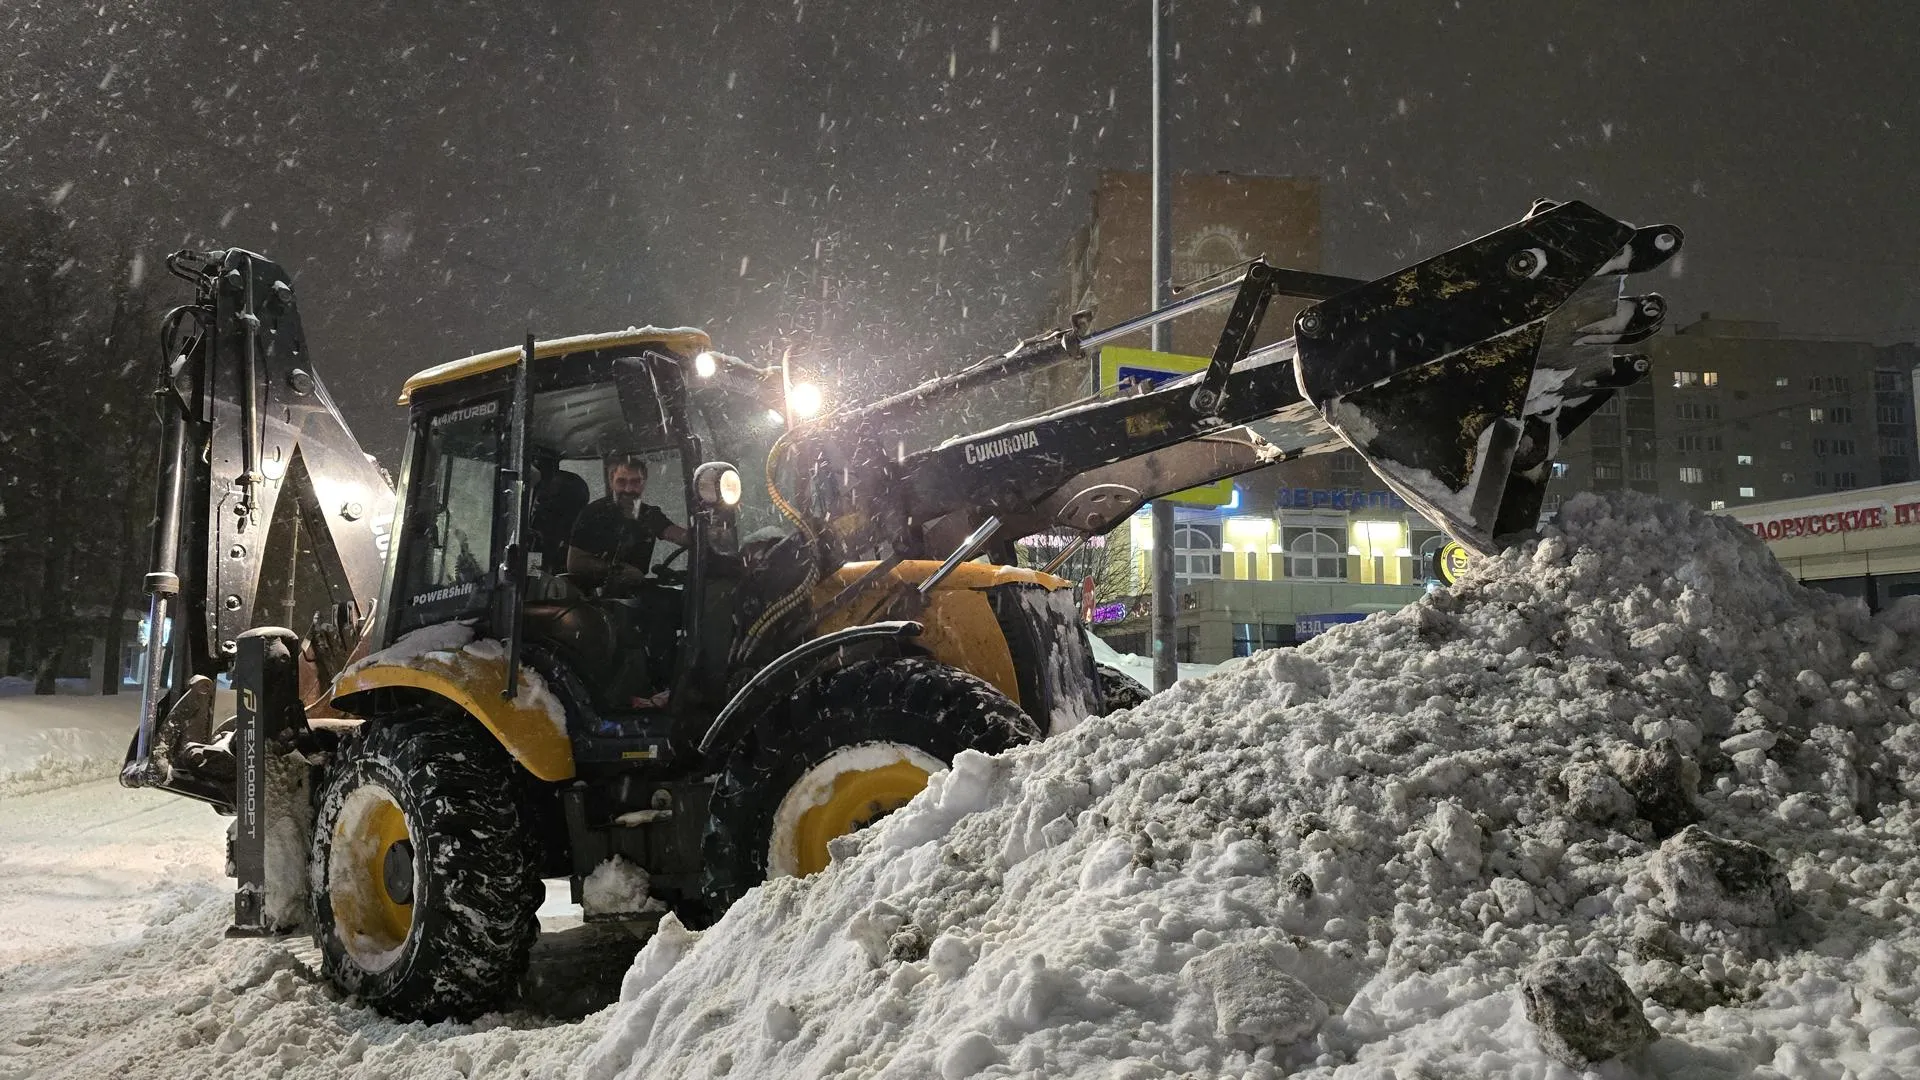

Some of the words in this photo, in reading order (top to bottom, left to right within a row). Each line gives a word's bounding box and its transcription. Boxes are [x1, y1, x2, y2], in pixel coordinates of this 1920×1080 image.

[965, 430, 1039, 465] CUKUROVA
[1744, 506, 1884, 539] ЛОРУССКИЕ
[247, 715, 256, 840] ТЕХНОФОРТ
